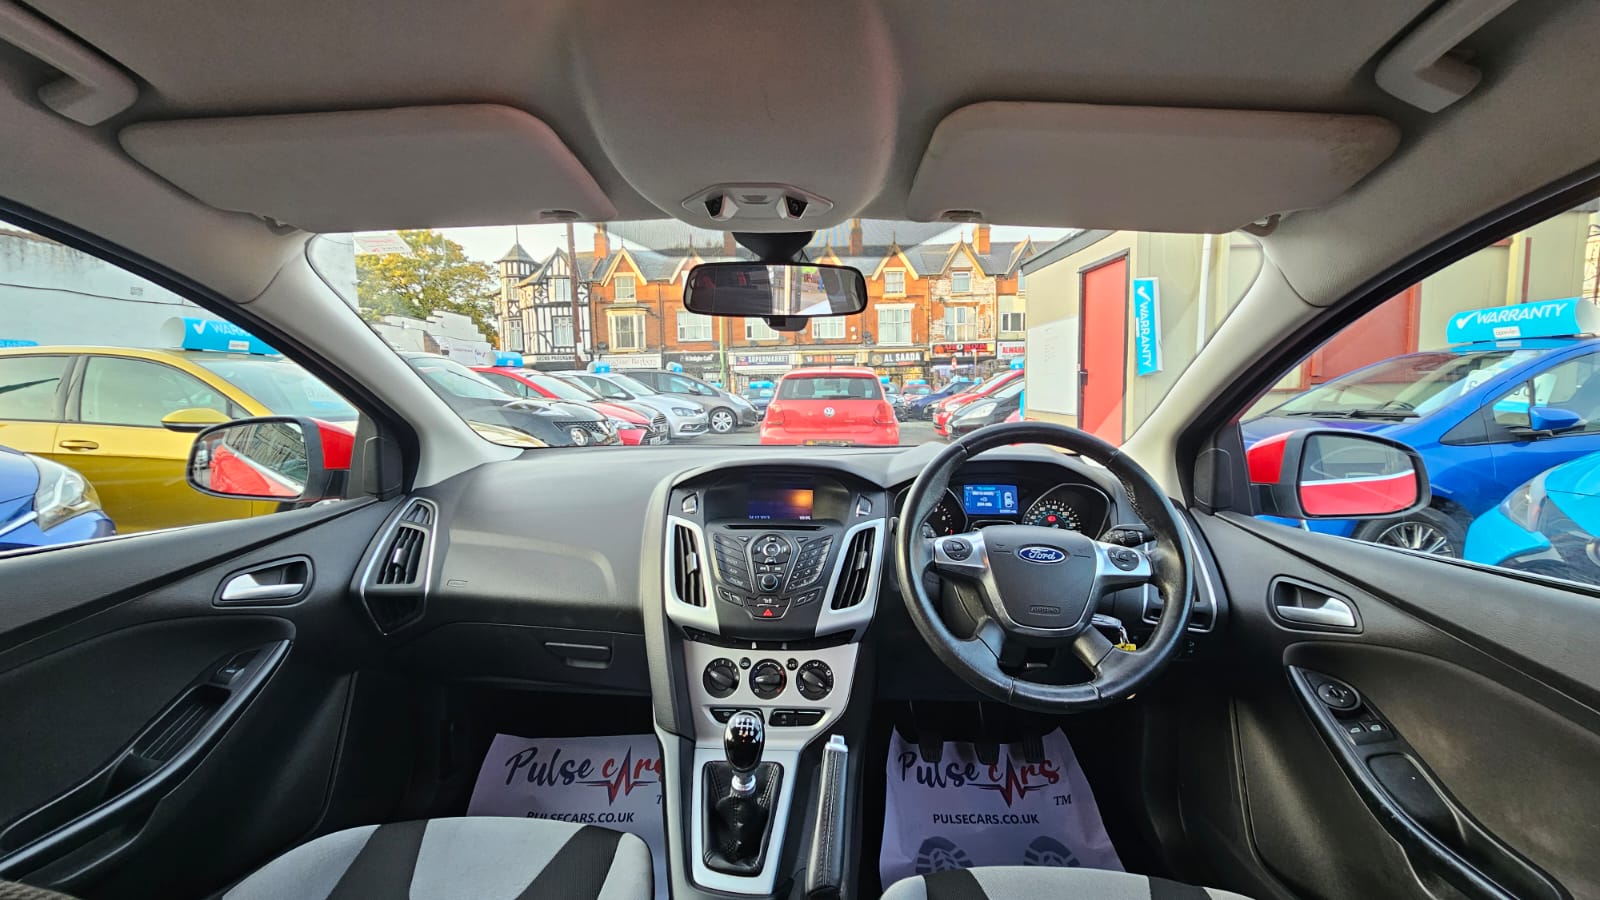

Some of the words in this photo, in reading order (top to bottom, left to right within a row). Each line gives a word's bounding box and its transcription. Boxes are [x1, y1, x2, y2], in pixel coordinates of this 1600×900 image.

[1476, 302, 1568, 324] WARRANTY
[1139, 301, 1152, 367] WARRANTY
[883, 354, 893, 362] AL
[895, 352, 921, 362] SAADA
[1028, 548, 1056, 560] Ford
[504, 747, 595, 786] Pulse
[897, 751, 979, 788] Pulse
[1053, 794, 1072, 806] TM
[933, 813, 1040, 825] PULSECARS.CO.UK
